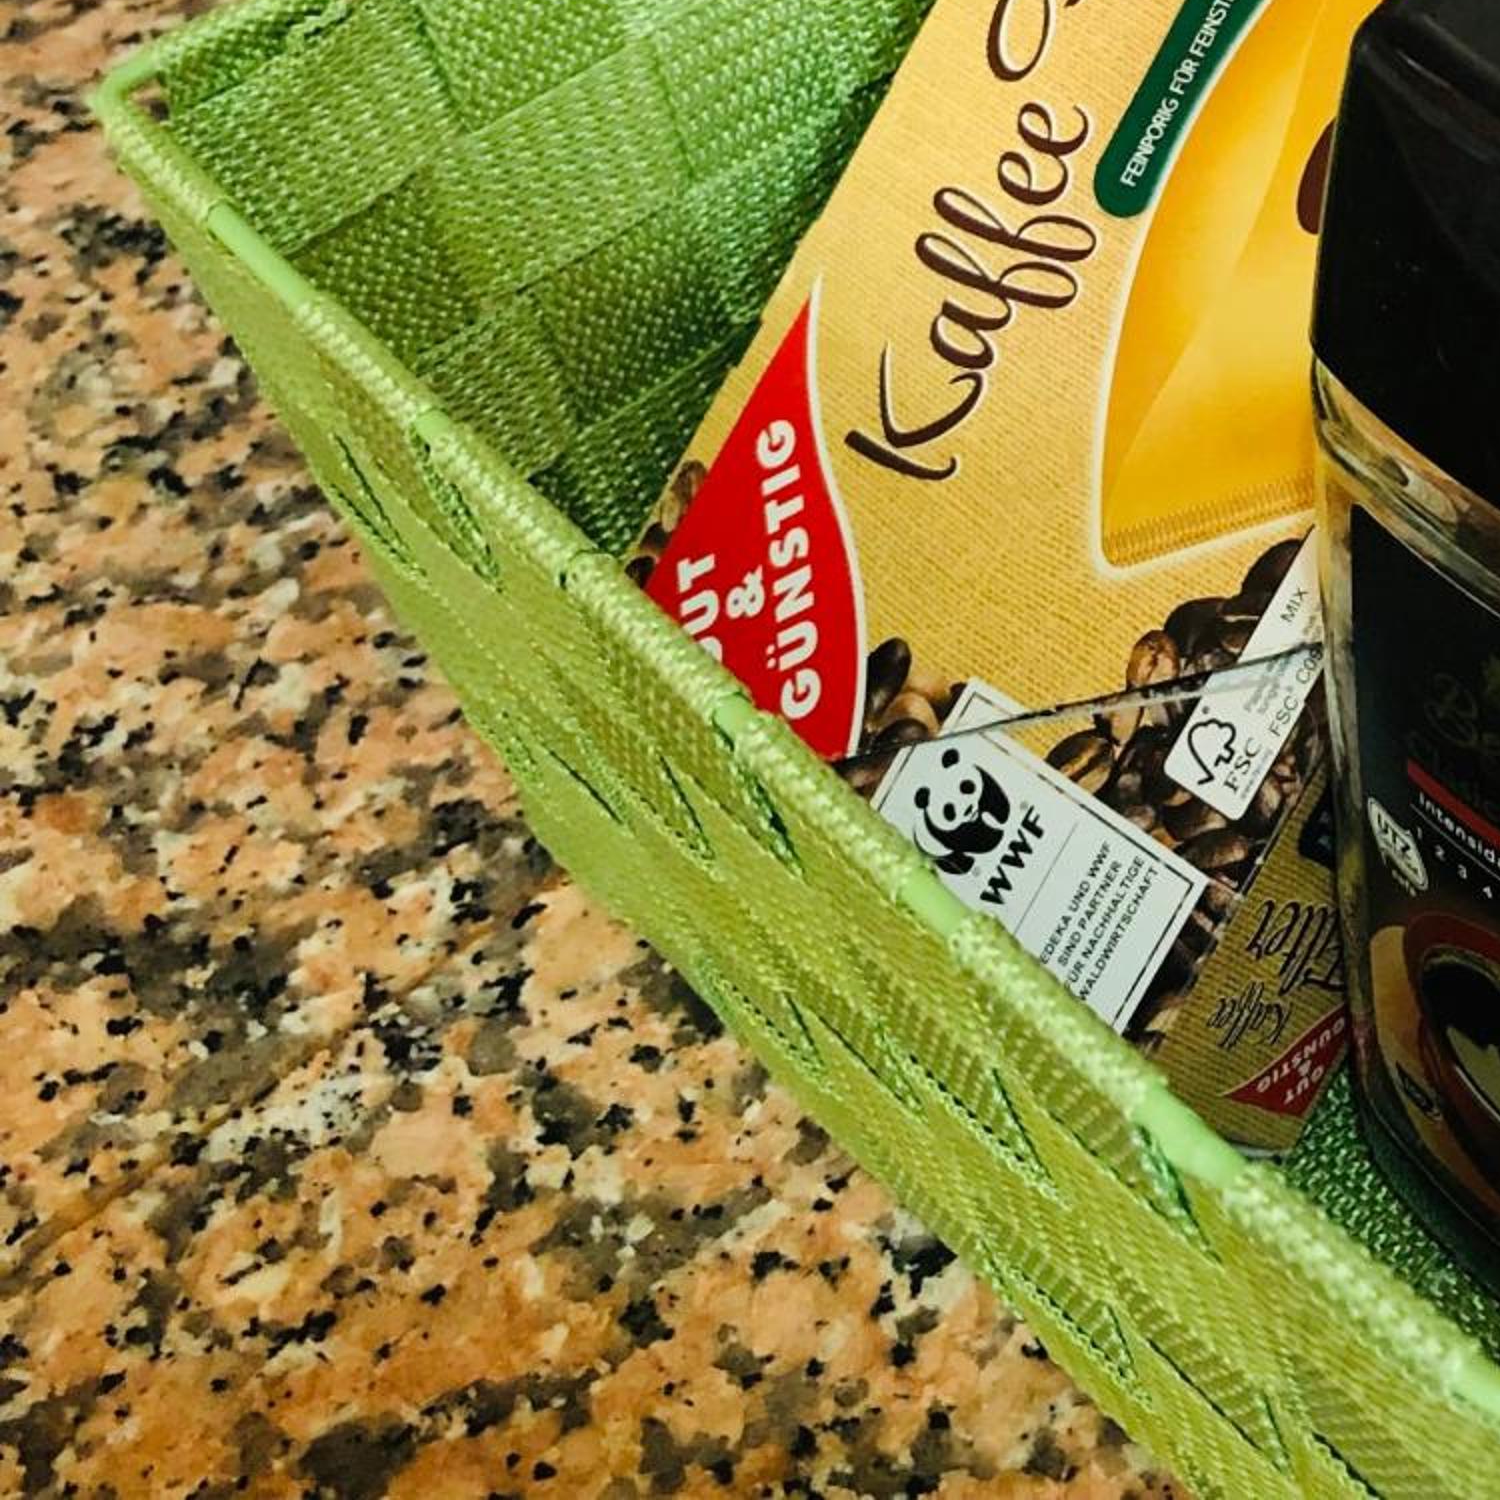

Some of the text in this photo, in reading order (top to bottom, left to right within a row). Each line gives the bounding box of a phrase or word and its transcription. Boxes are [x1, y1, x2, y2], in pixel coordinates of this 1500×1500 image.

[1119, 97, 1180, 188] FEINPORIG
[1168, 57, 1201, 96] FÜR
[844, 101, 1098, 481] Kaffee
[725, 564, 766, 619] &
[755, 419, 822, 720] GÜNSTIG
[1280, 586, 1310, 624] MIX
[979, 804, 1045, 905] WWF
[1039, 841, 1112, 965] EDEKA UND WWF
[1081, 854, 1146, 960] NACHHALTIGE
[1435, 845, 1447, 861] 2
[1457, 864, 1468, 880] 3
[1482, 884, 1494, 900] 4
[1057, 859, 1123, 967] SIND PARTNER
[1078, 866, 1160, 1001] WALDWIRTSCHAFT
[1206, 978, 1295, 1050] Kaffee
[1283, 1064, 1326, 1106] GUT
